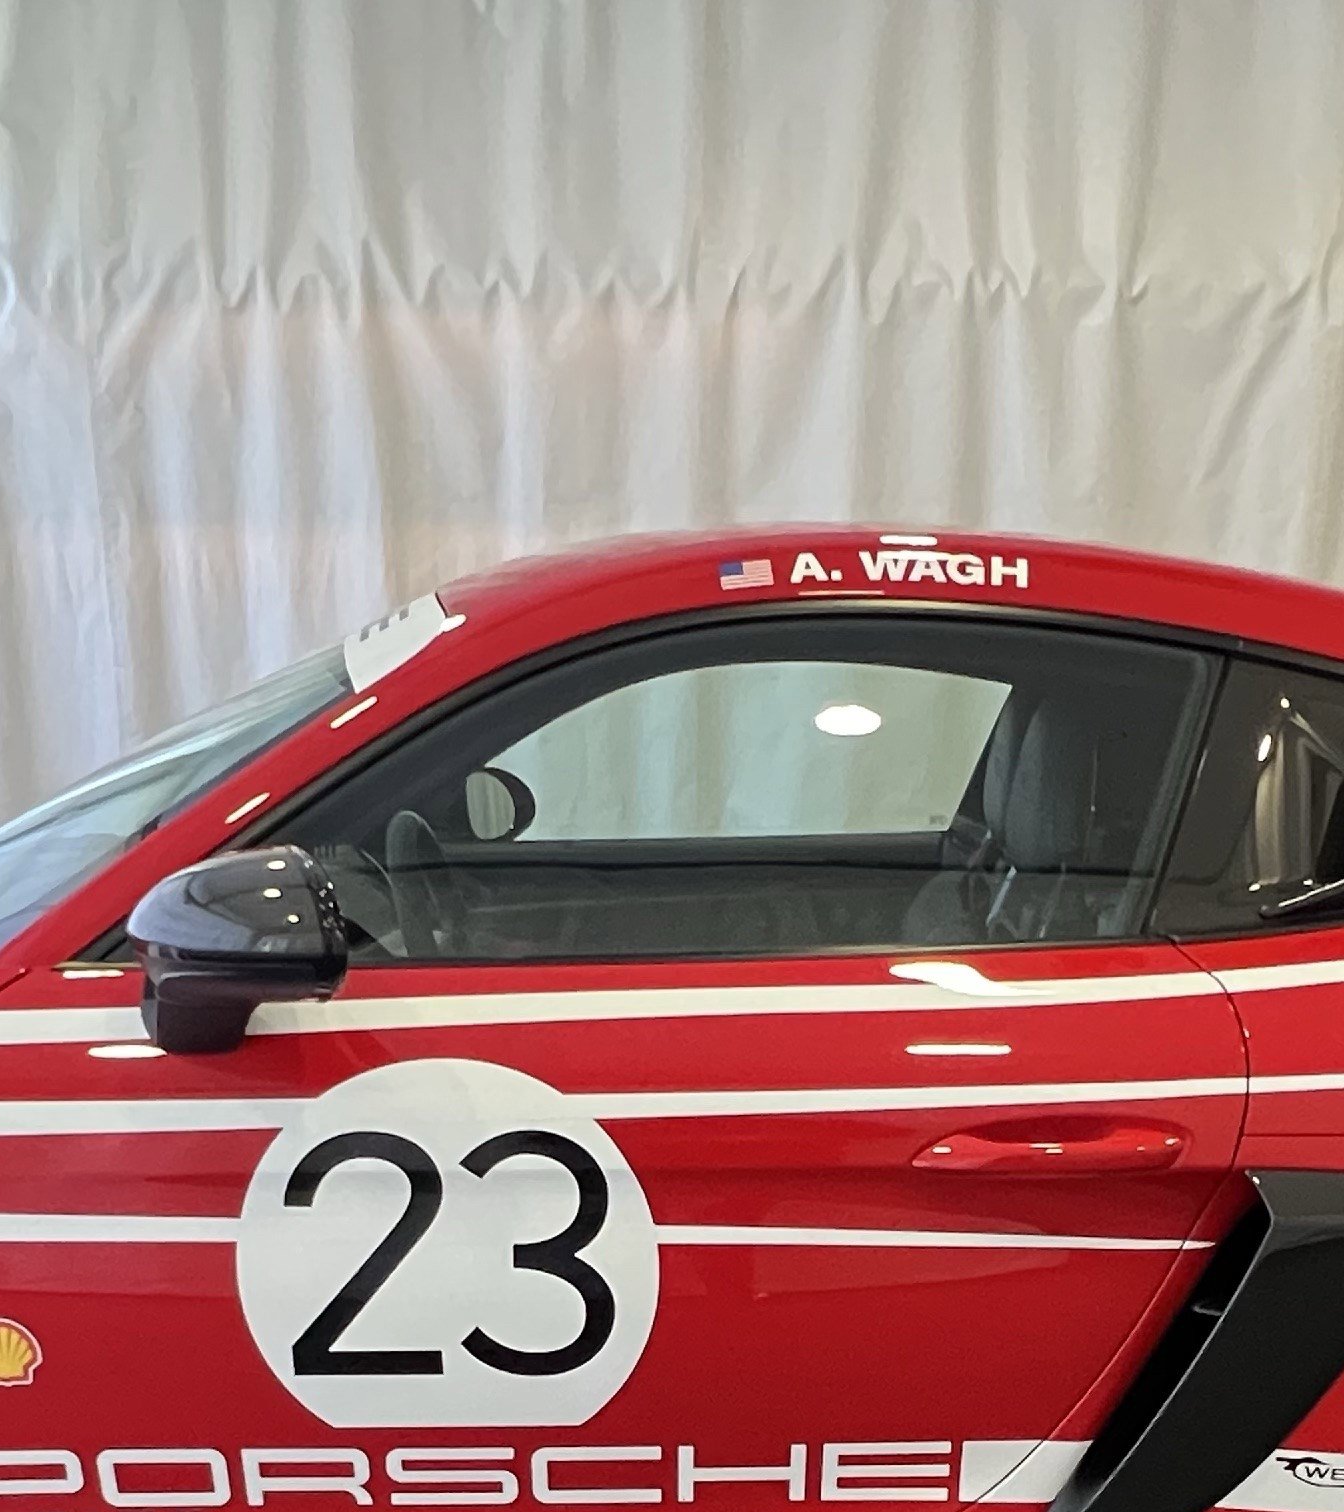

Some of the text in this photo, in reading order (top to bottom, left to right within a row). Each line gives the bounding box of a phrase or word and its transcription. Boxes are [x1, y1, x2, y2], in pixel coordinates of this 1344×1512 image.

[790, 550, 1028, 589] A. WAGH
[283, 1130, 616, 1378] 23
